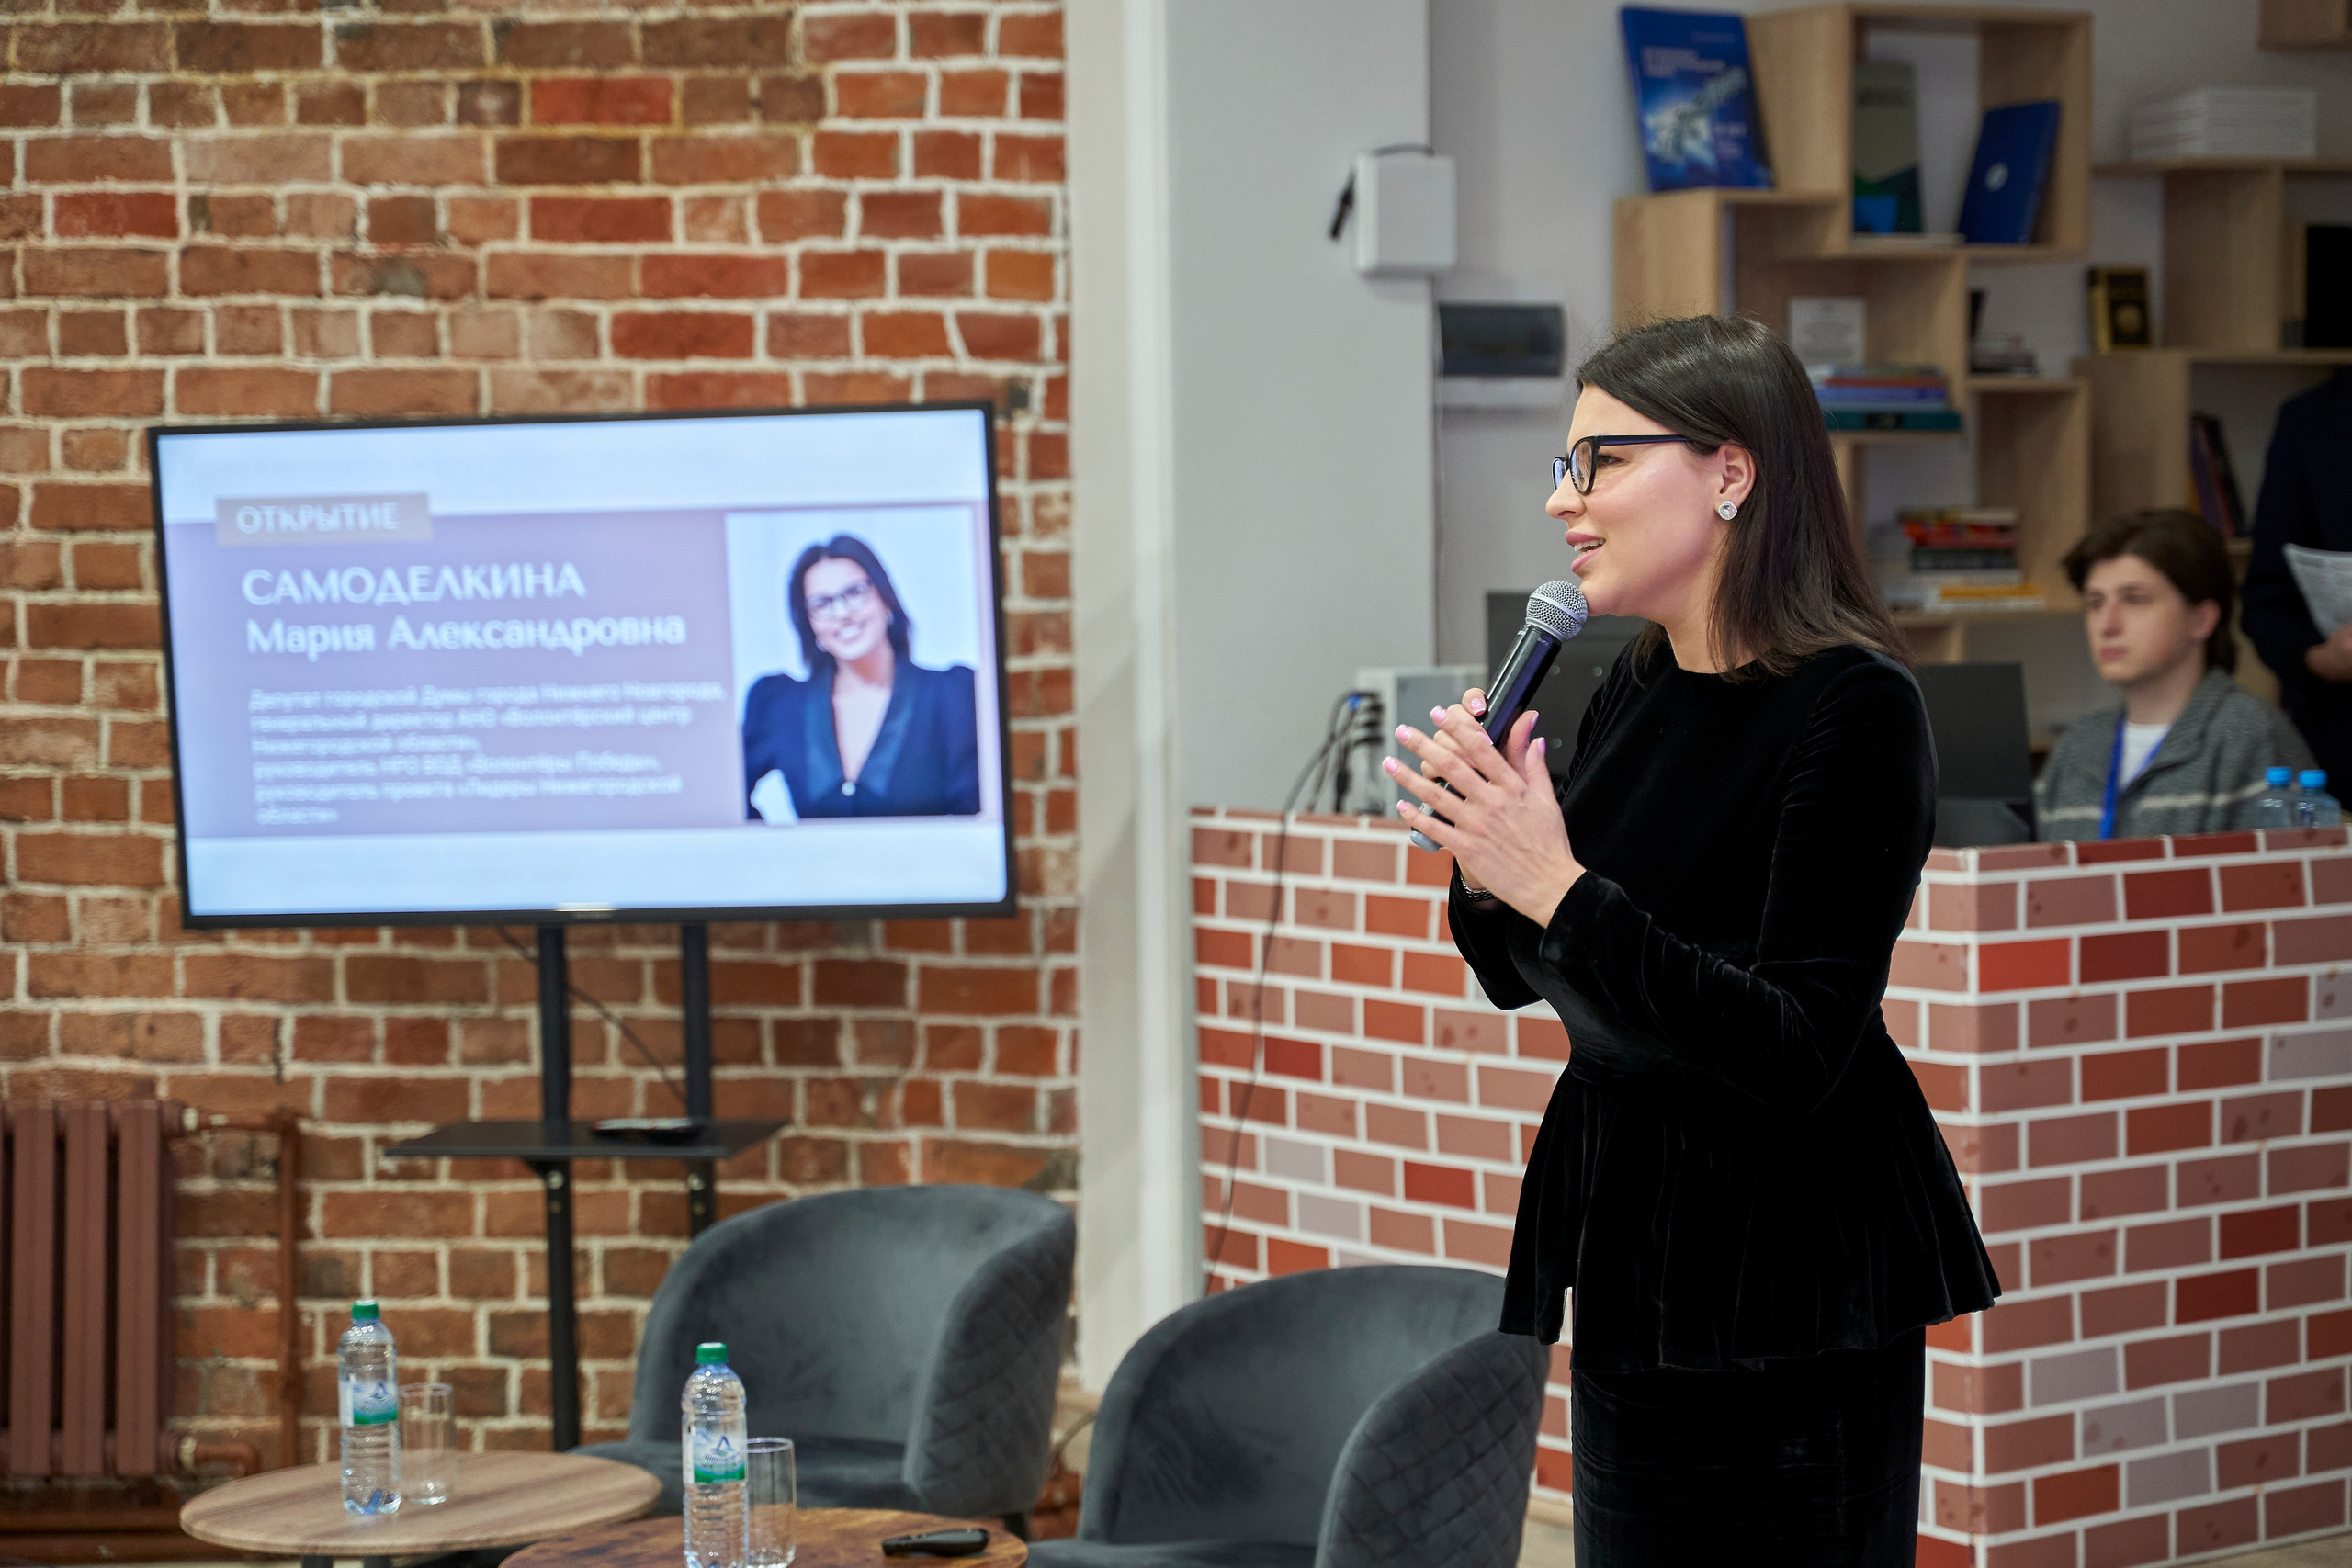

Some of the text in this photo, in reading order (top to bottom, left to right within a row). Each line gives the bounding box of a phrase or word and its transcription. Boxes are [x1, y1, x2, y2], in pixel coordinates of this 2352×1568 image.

[236, 502, 400, 534] ОТКРЫТИЕ
[243, 562, 587, 606] САМОДЕЛКИНА
[246, 615, 686, 661] Мария Александровна
[249, 689, 322, 711] Депутат
[324, 686, 417, 709] городской
[421, 685, 473, 707] Думы
[476, 684, 537, 705] города
[541, 682, 619, 702] Нижнего
[370, 713, 453, 731] директор
[639, 705, 692, 725] центр
[253, 736, 392, 755] Нижегородской
[254, 760, 377, 781] руководитель
[255, 783, 379, 802] руководитель
[381, 781, 454, 800] проекта
[540, 773, 682, 795] Нижегородской
